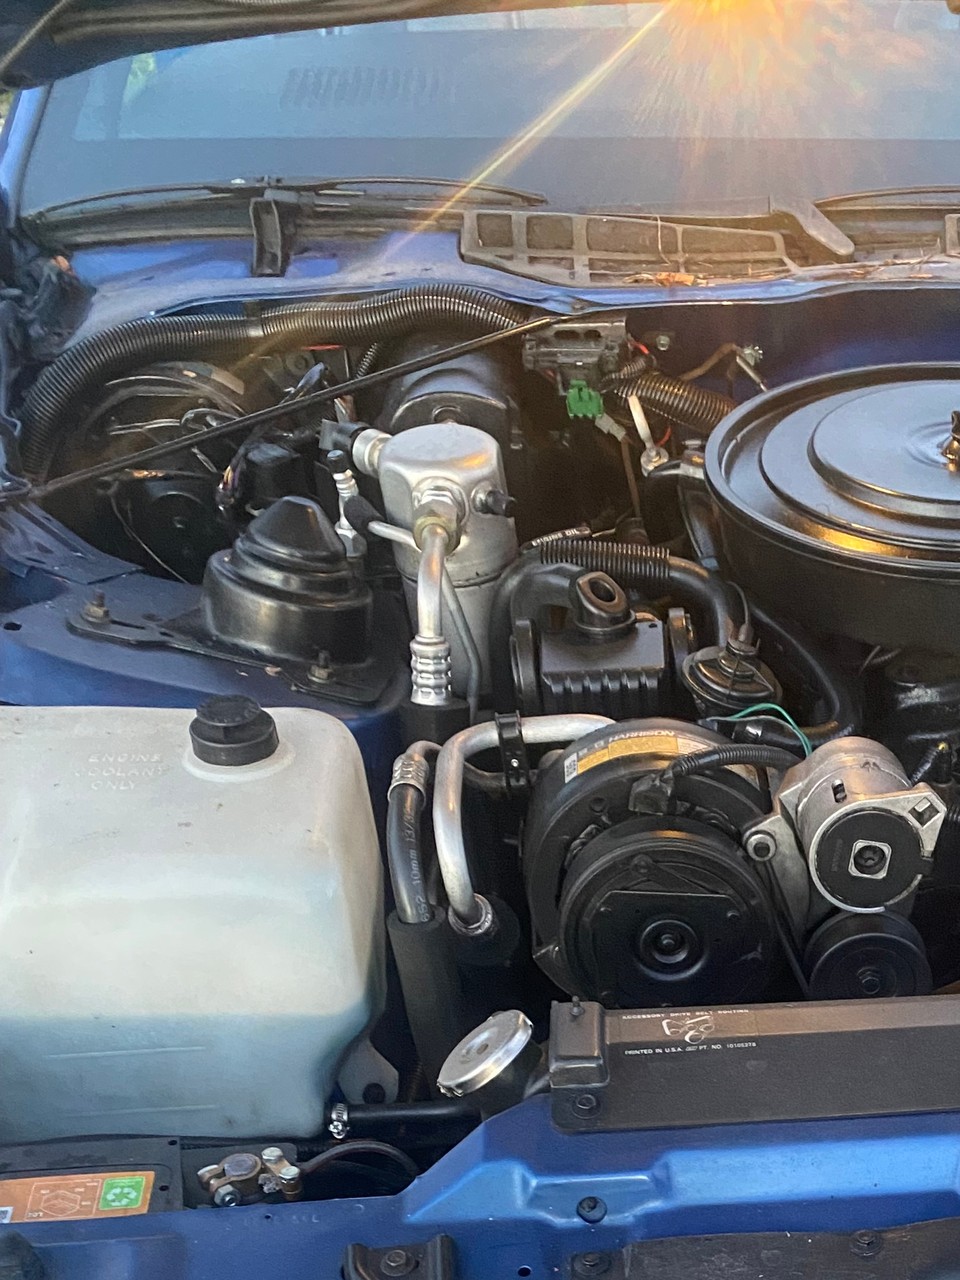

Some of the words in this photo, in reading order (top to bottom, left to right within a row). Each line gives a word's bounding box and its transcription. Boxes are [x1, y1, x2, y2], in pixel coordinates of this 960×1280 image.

[565, 528, 580, 537] OIL
[608, 729, 675, 743] HARRISON
[88, 753, 162, 763] ENGINE
[72, 766, 168, 777] COOLANT
[90, 780, 138, 791] ONLY
[409, 849, 422, 886] 10mm
